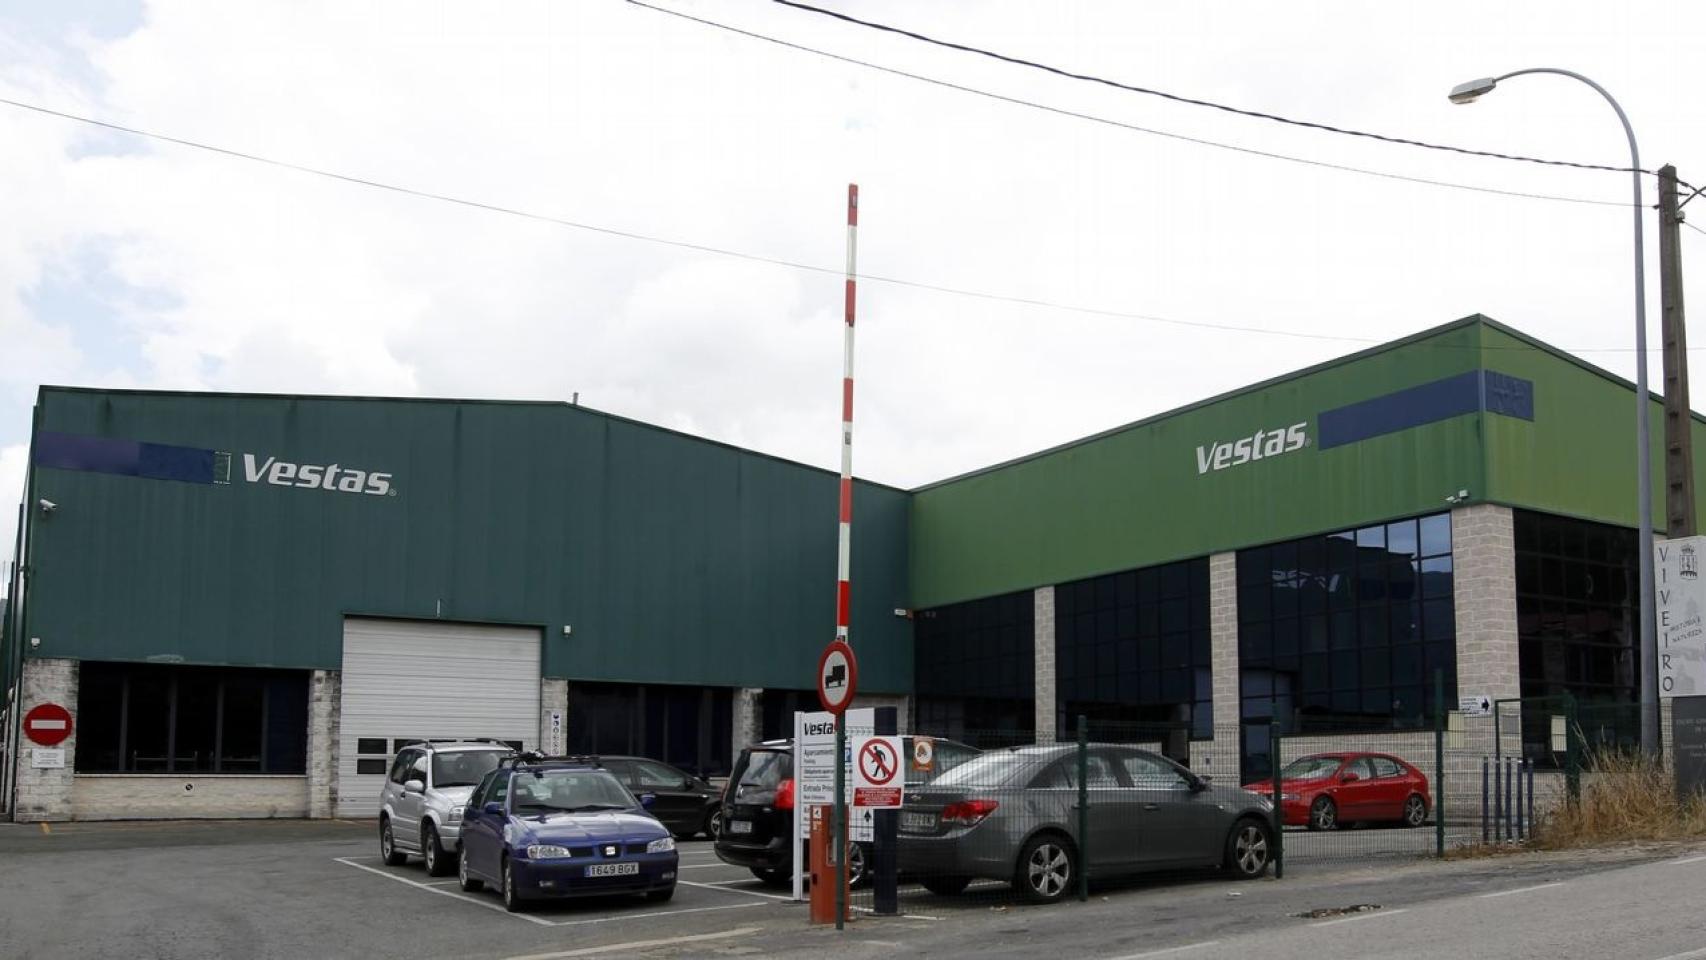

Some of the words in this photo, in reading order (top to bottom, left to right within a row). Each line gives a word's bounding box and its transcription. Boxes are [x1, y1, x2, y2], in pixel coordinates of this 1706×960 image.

[1196, 422, 1307, 474] Vestas
[243, 453, 392, 496] Vestas
[804, 722, 834, 736] Vesta
[592, 864, 616, 875] 1649
